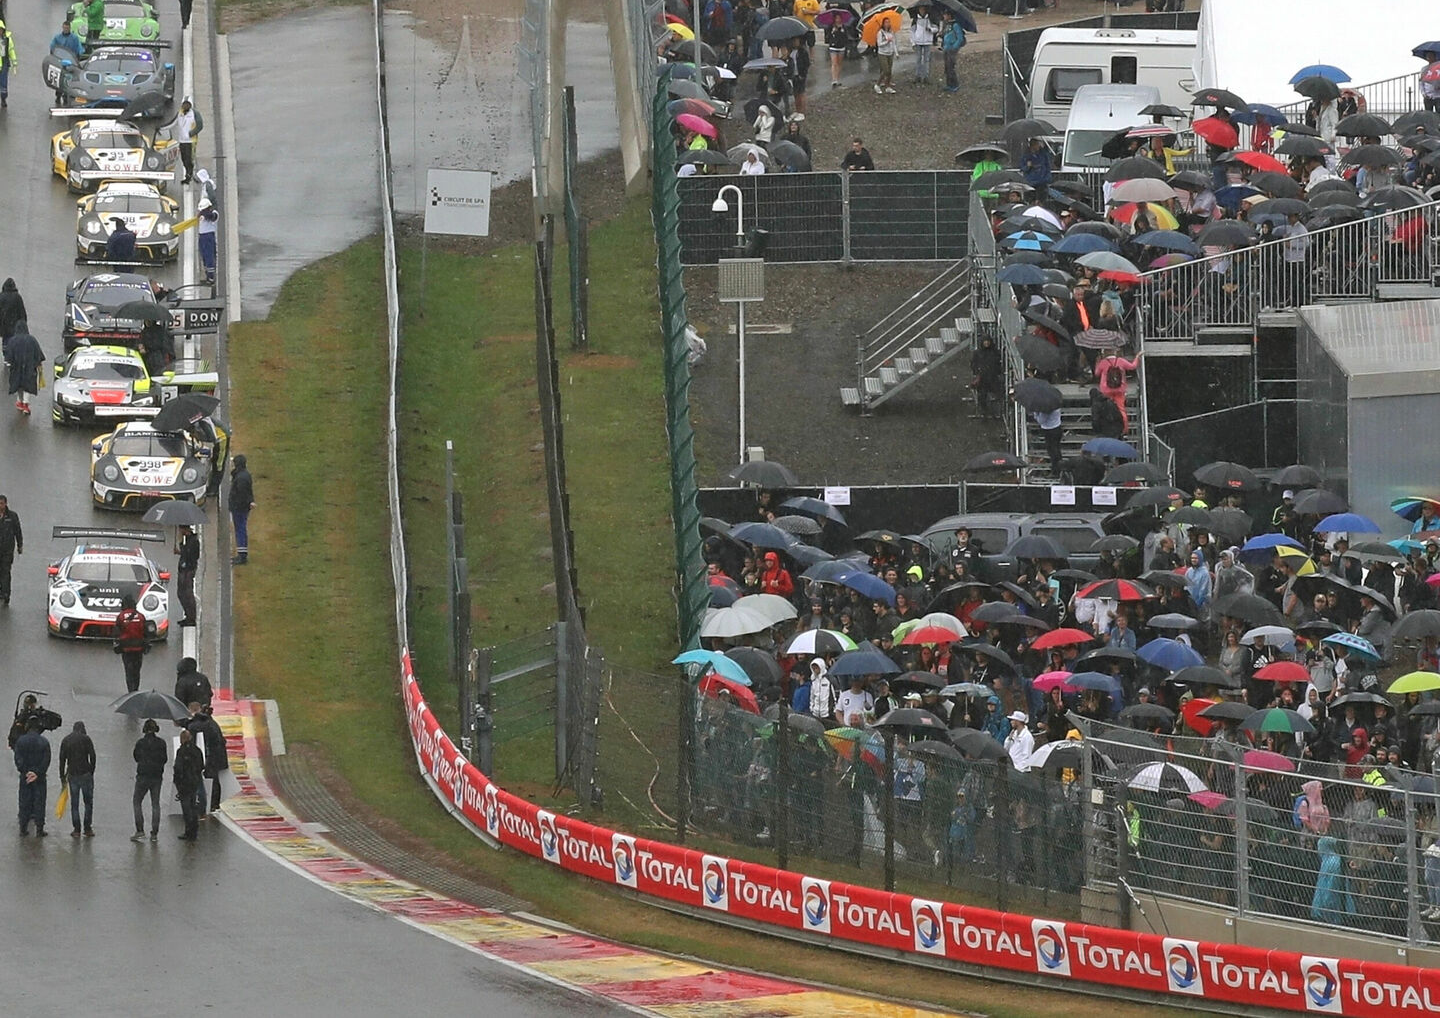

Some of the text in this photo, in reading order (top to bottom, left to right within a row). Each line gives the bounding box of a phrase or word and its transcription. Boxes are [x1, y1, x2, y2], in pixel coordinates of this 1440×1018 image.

[190, 312, 218, 323] DON
[131, 476, 173, 484] ROWE
[140, 461, 161, 469] 998
[498, 804, 540, 845] TOTAL
[558, 828, 613, 869] TOTAL
[638, 850, 700, 892] TOTAL
[731, 872, 799, 914] TOTAL
[832, 894, 911, 937] TOTAL
[946, 916, 1032, 958] TOTAL
[1070, 936, 1163, 977] TOTAL
[1203, 954, 1300, 996] TOTAL
